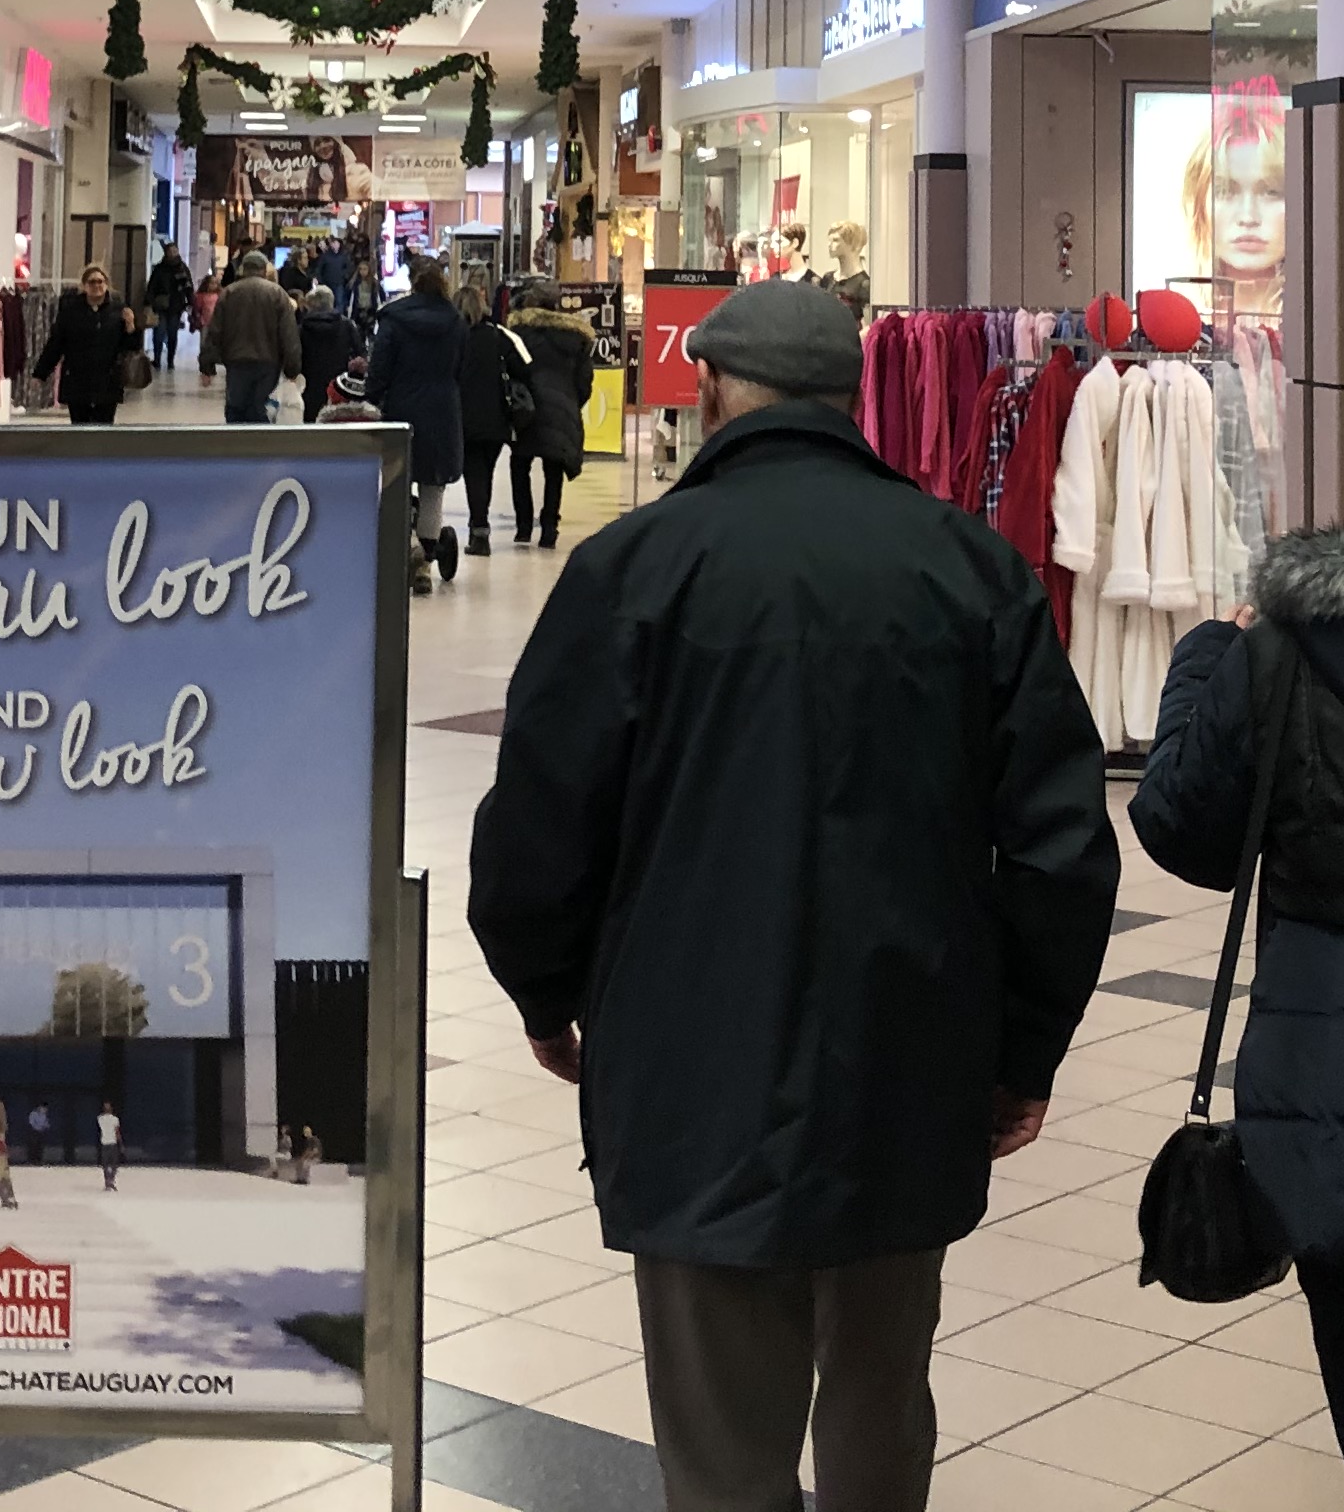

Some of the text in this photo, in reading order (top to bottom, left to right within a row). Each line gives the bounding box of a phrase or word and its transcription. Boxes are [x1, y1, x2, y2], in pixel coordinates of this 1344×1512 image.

[269, 140, 303, 151] POUR
[104, 477, 312, 624] look
[60, 682, 208, 791] look
[168, 934, 215, 1008] 3
